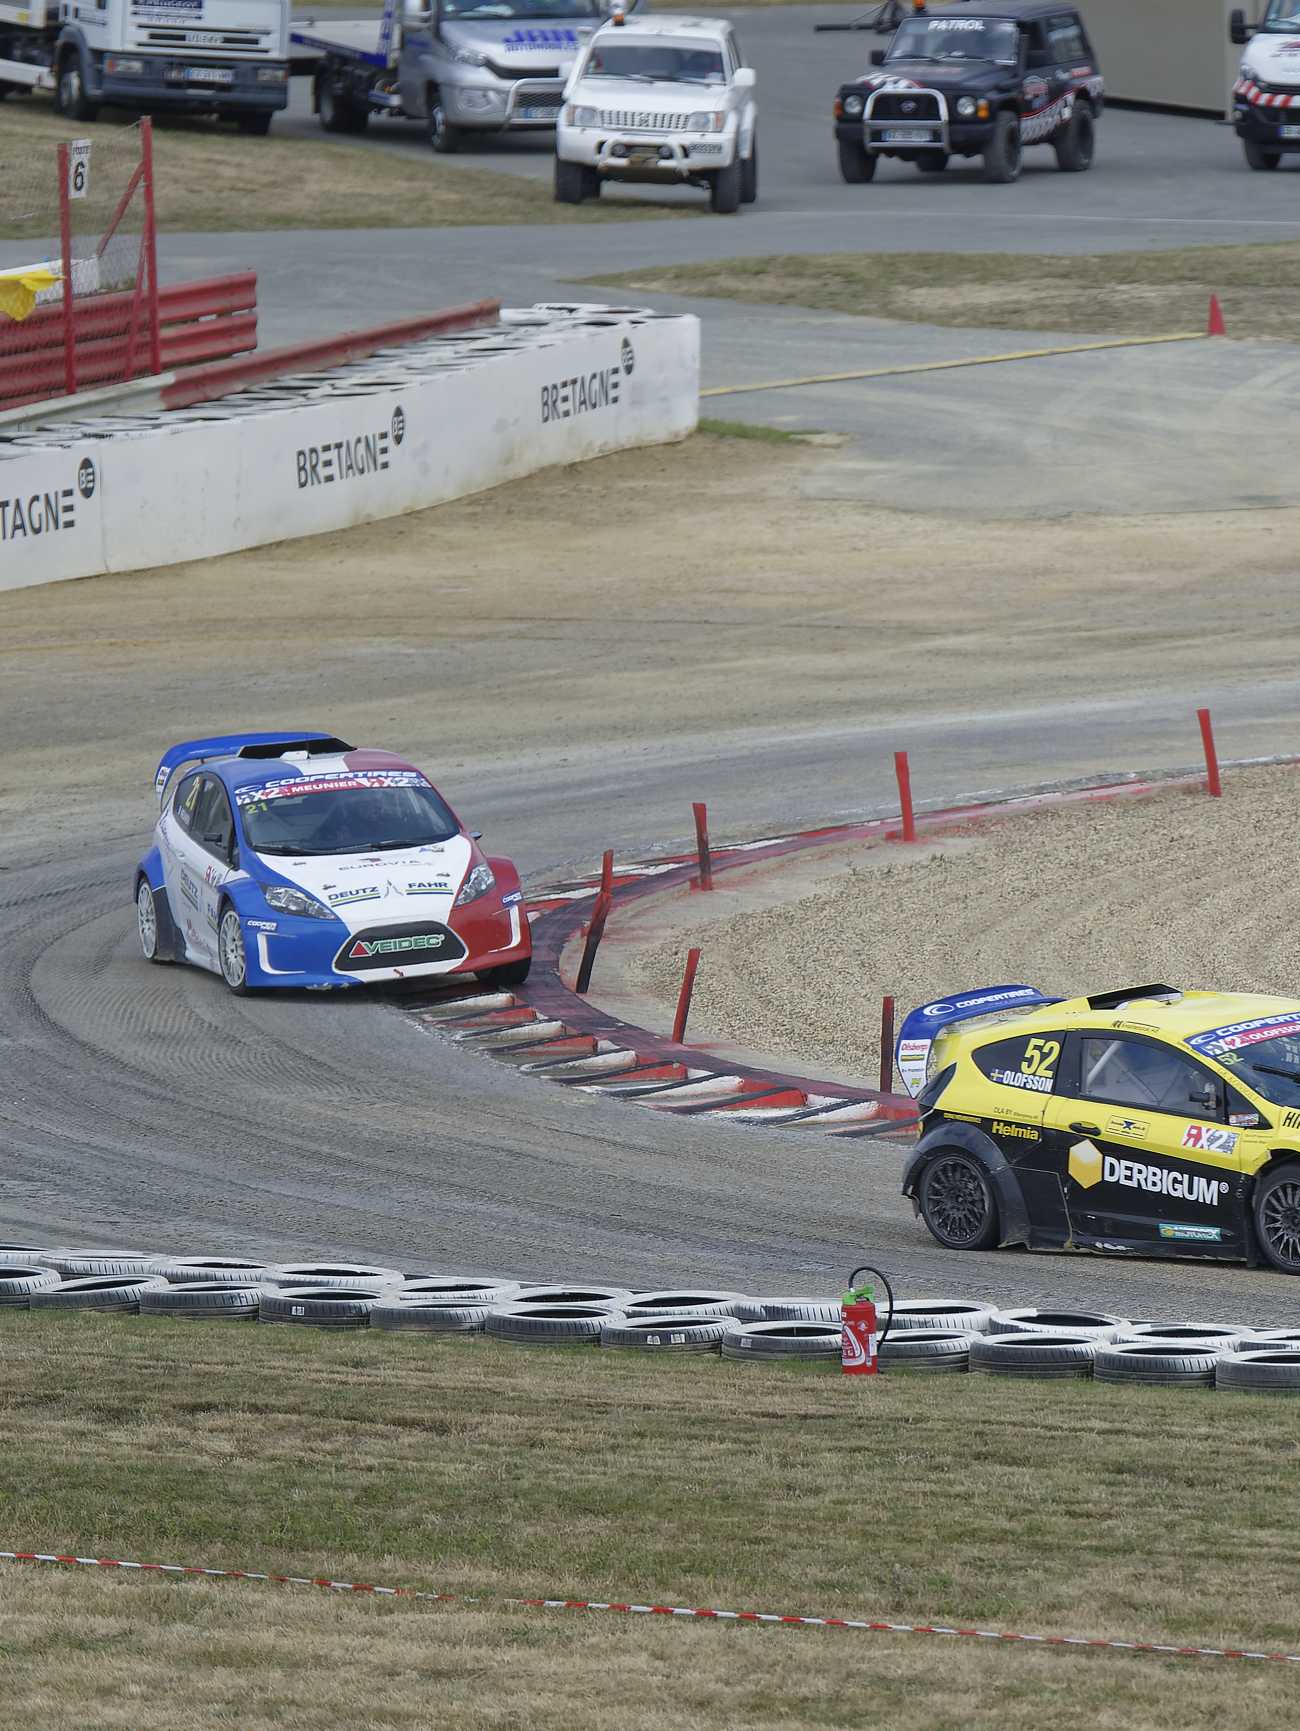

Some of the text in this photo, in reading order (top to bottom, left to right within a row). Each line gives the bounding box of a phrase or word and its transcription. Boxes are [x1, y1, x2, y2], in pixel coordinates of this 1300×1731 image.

[928, 19, 986, 32] PATROL
[74, 160, 85, 191] 6
[541, 366, 620, 424] BRETAGNE
[296, 431, 390, 489] BRETAGNE
[291, 780, 357, 793] MEUNIER
[246, 802, 268, 815] 21
[328, 886, 379, 901] DEUTZ
[408, 881, 449, 889] FAHR
[1021, 1038, 1060, 1078] 52
[1216, 1052, 1244, 1066] 52
[1003, 1070, 1054, 1092] OLOFSSON
[992, 1121, 1040, 1141] Helmia
